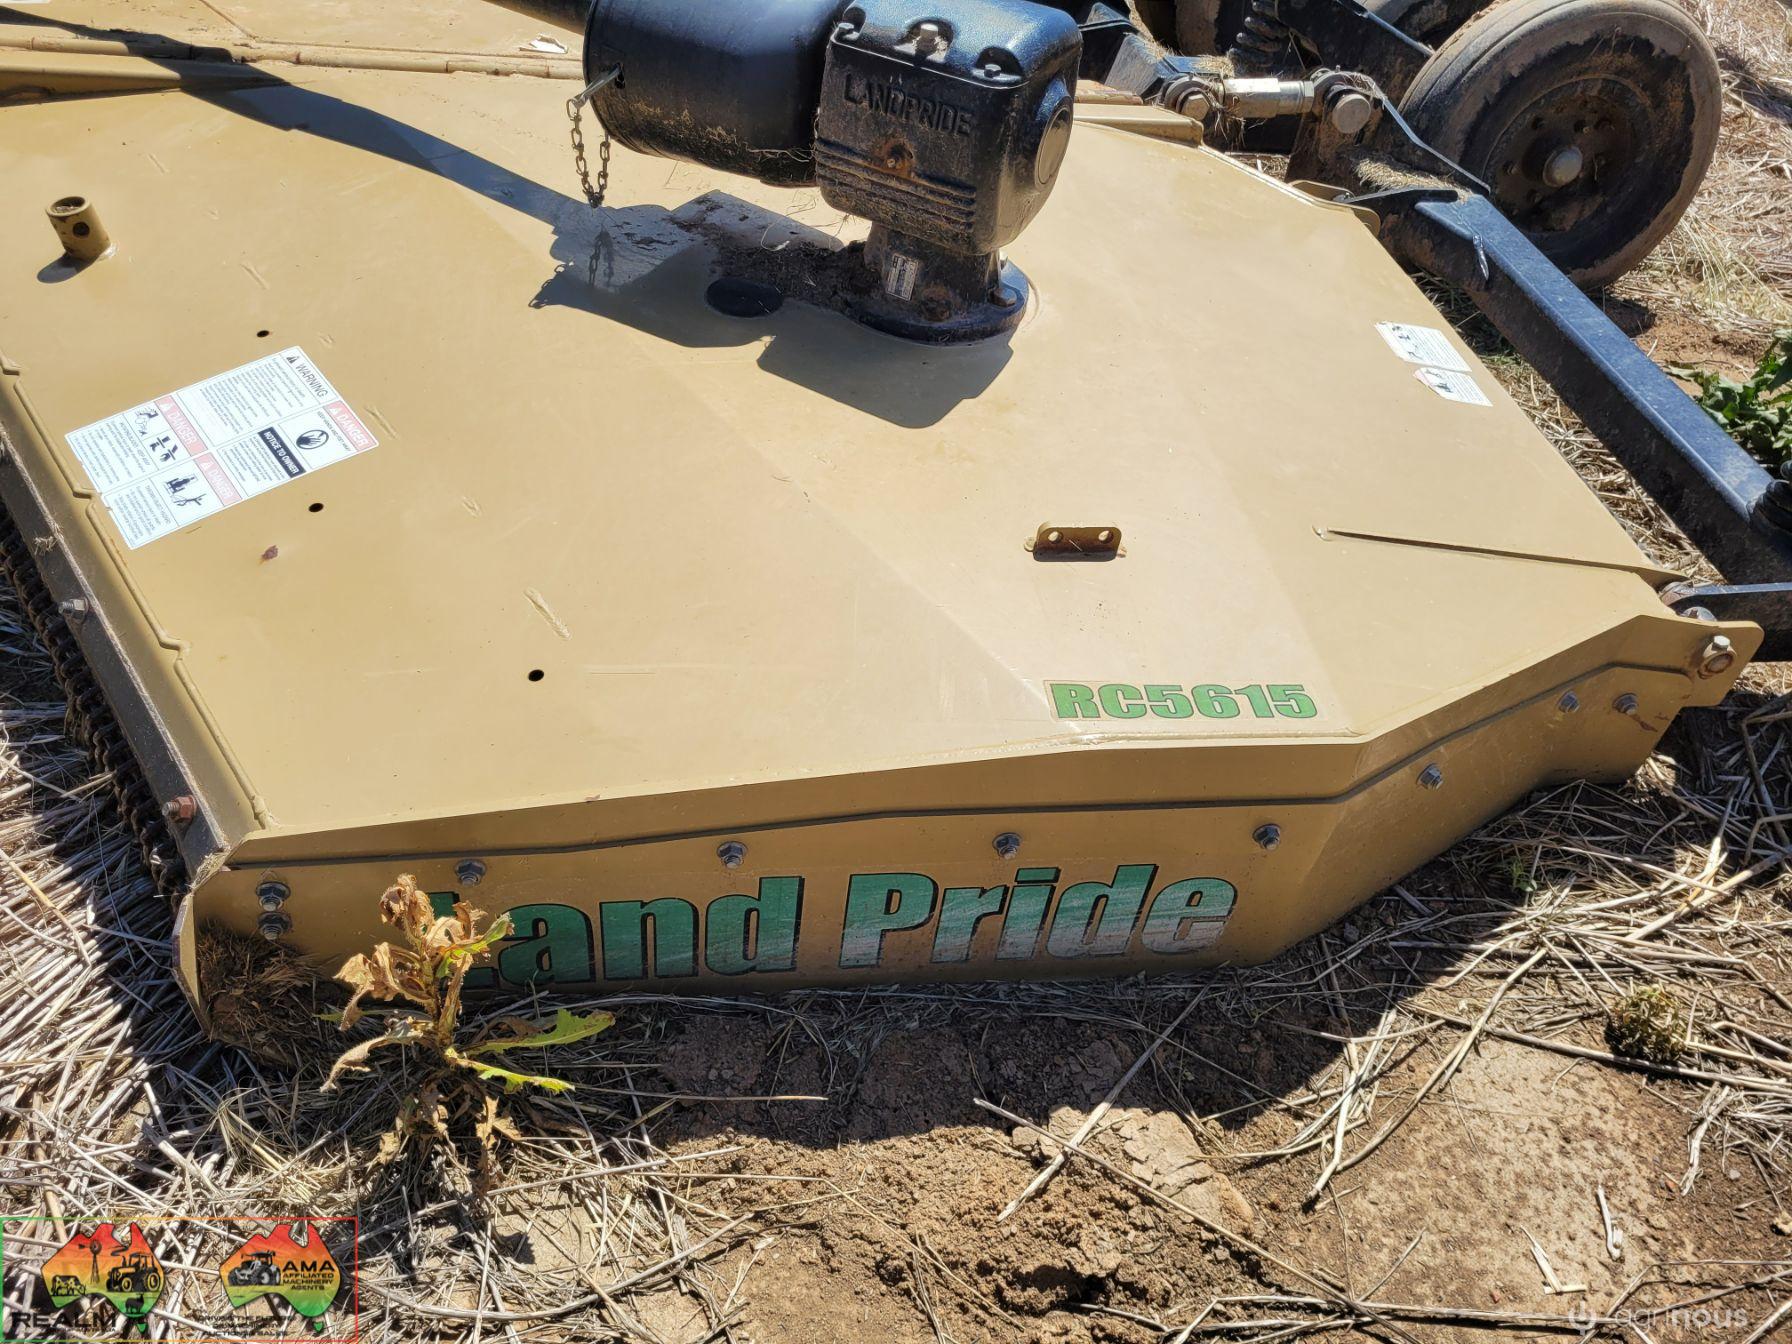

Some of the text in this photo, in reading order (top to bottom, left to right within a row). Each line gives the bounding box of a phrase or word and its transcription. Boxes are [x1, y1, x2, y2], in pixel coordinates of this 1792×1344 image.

[294, 363, 329, 397] WARNING
[166, 410, 198, 445] DANGER
[335, 413, 369, 446] DANGER
[263, 431, 299, 474] NOTICE TO OWNER
[206, 468, 235, 499] DANGER
[1049, 683, 1318, 719] RC5615
[838, 864, 1238, 969] Pride
